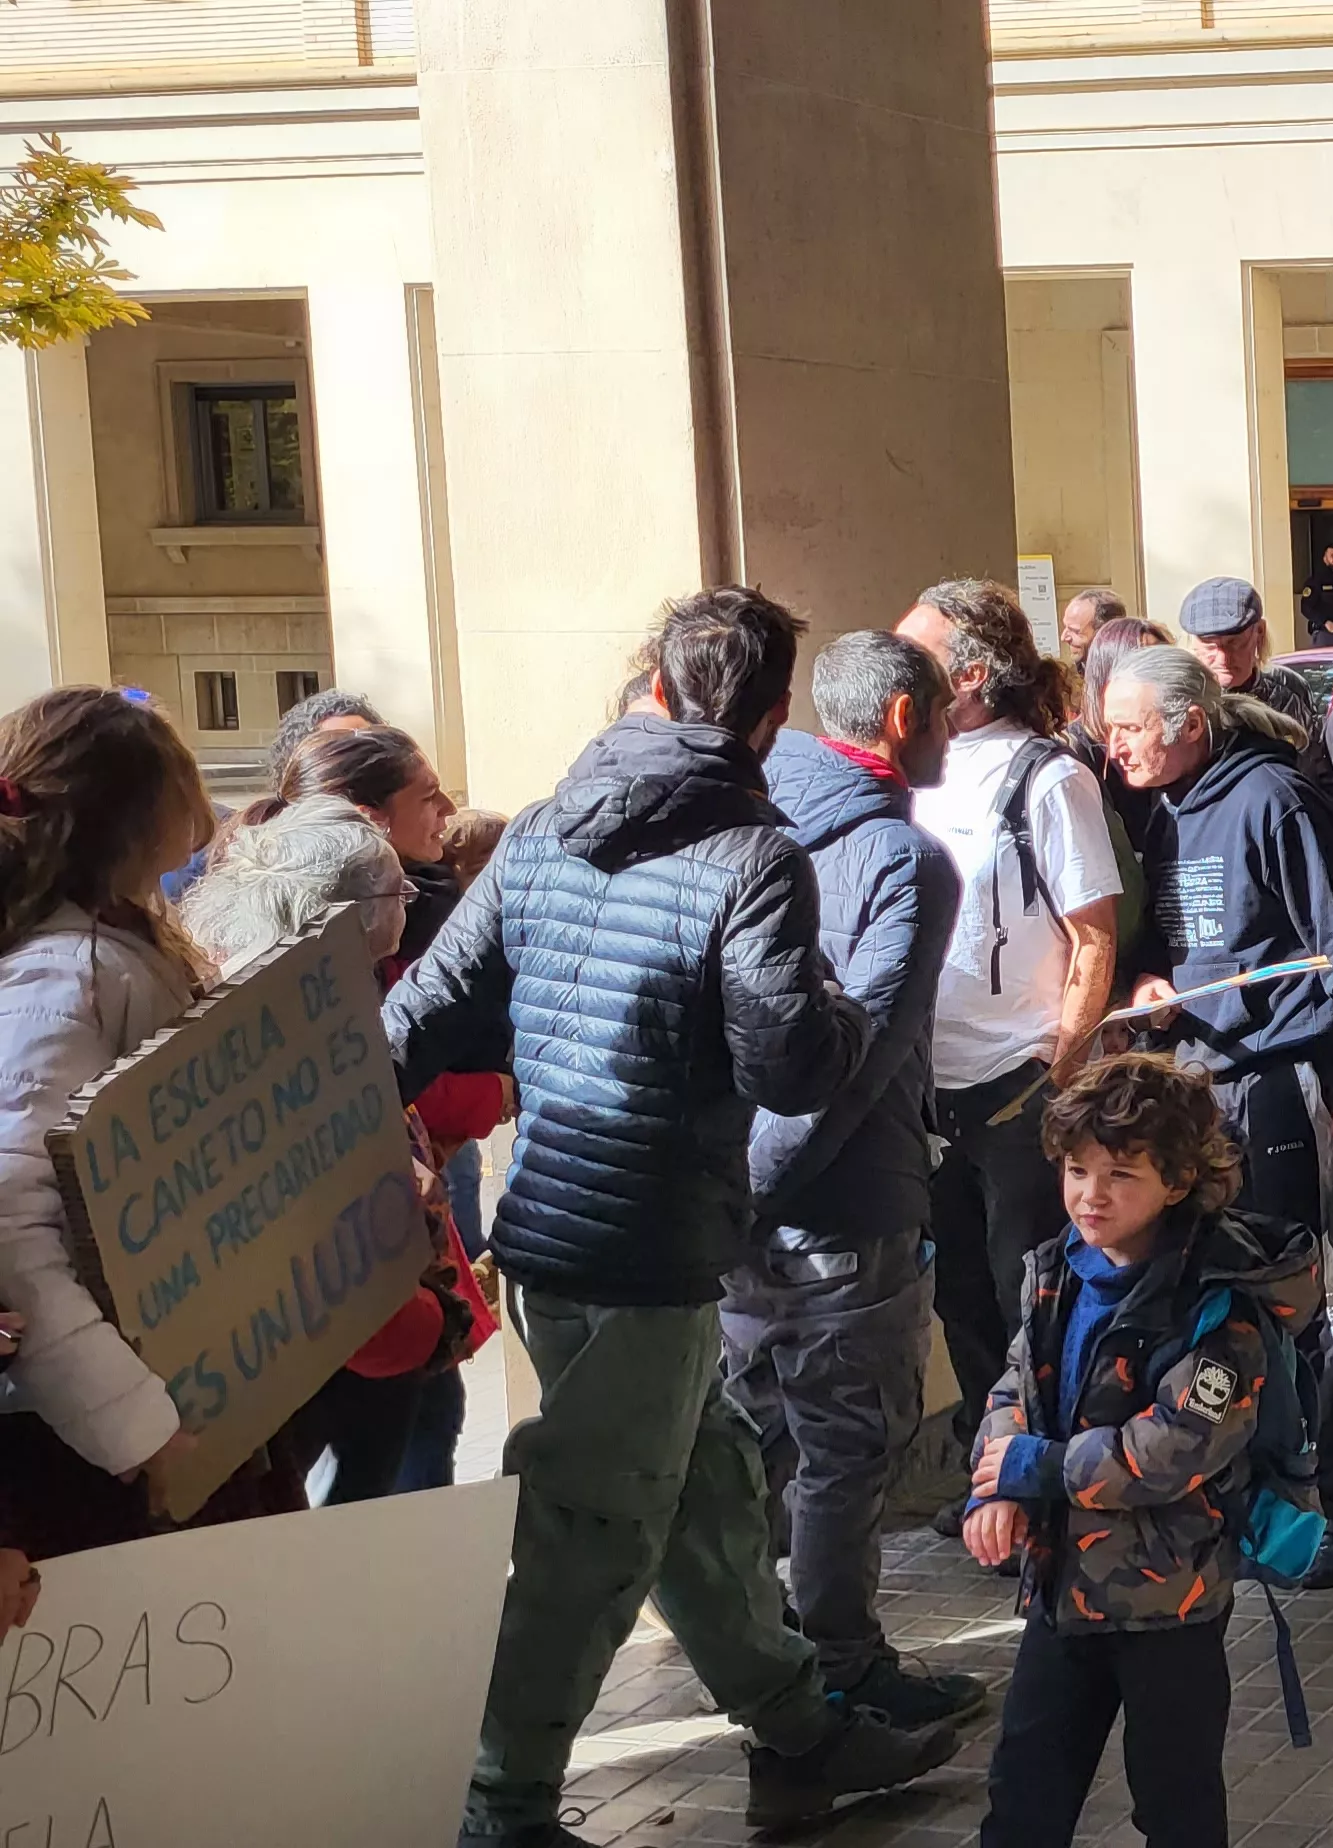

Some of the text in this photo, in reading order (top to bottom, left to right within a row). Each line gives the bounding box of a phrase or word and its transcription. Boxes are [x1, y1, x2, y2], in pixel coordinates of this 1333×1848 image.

[85, 954, 343, 1193] LA ESCUELA DE
[118, 1015, 368, 1255] CANETO NO ES
[137, 1081, 384, 1331] UNA PRECARIEDAD
[230, 1297, 292, 1381] UN
[290, 1171, 414, 1342] LUJO
